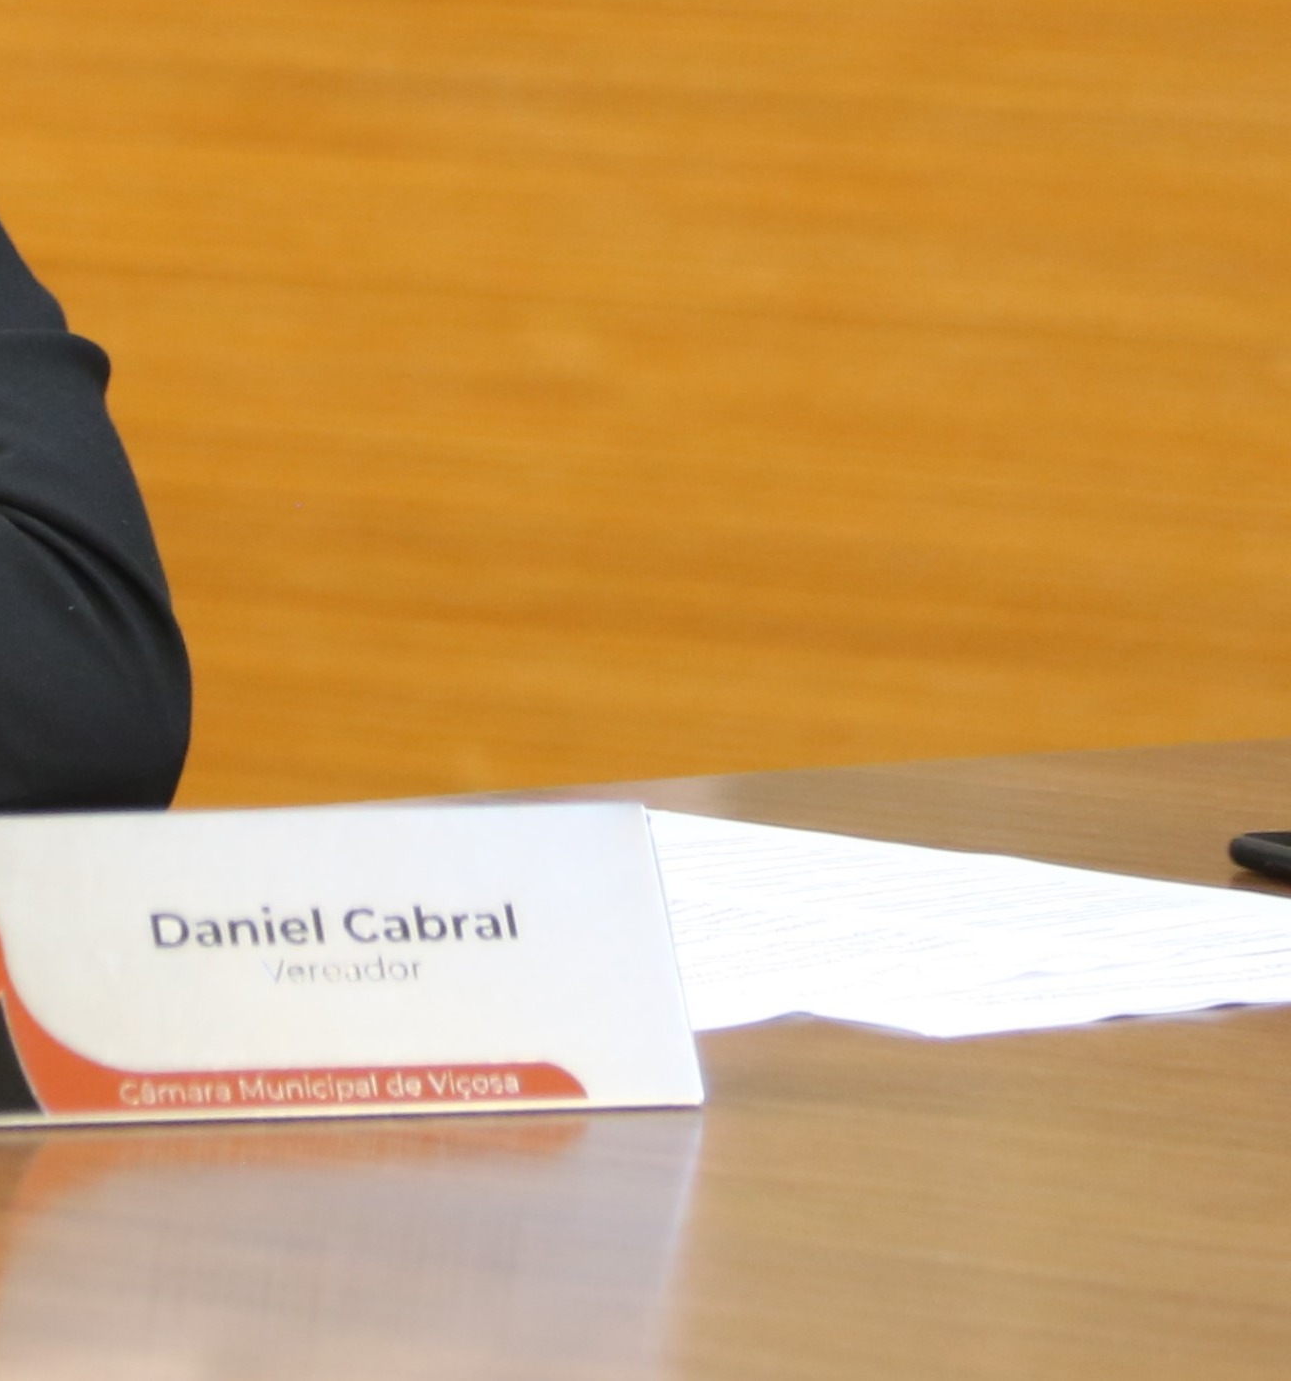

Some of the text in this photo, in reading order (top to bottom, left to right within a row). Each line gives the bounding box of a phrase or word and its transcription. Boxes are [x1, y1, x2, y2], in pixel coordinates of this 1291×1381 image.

[150, 902, 519, 949] Daniel Cabral
[261, 953, 420, 984] Vereador
[119, 1069, 520, 1106] Câmara Municipal de Viçosa
